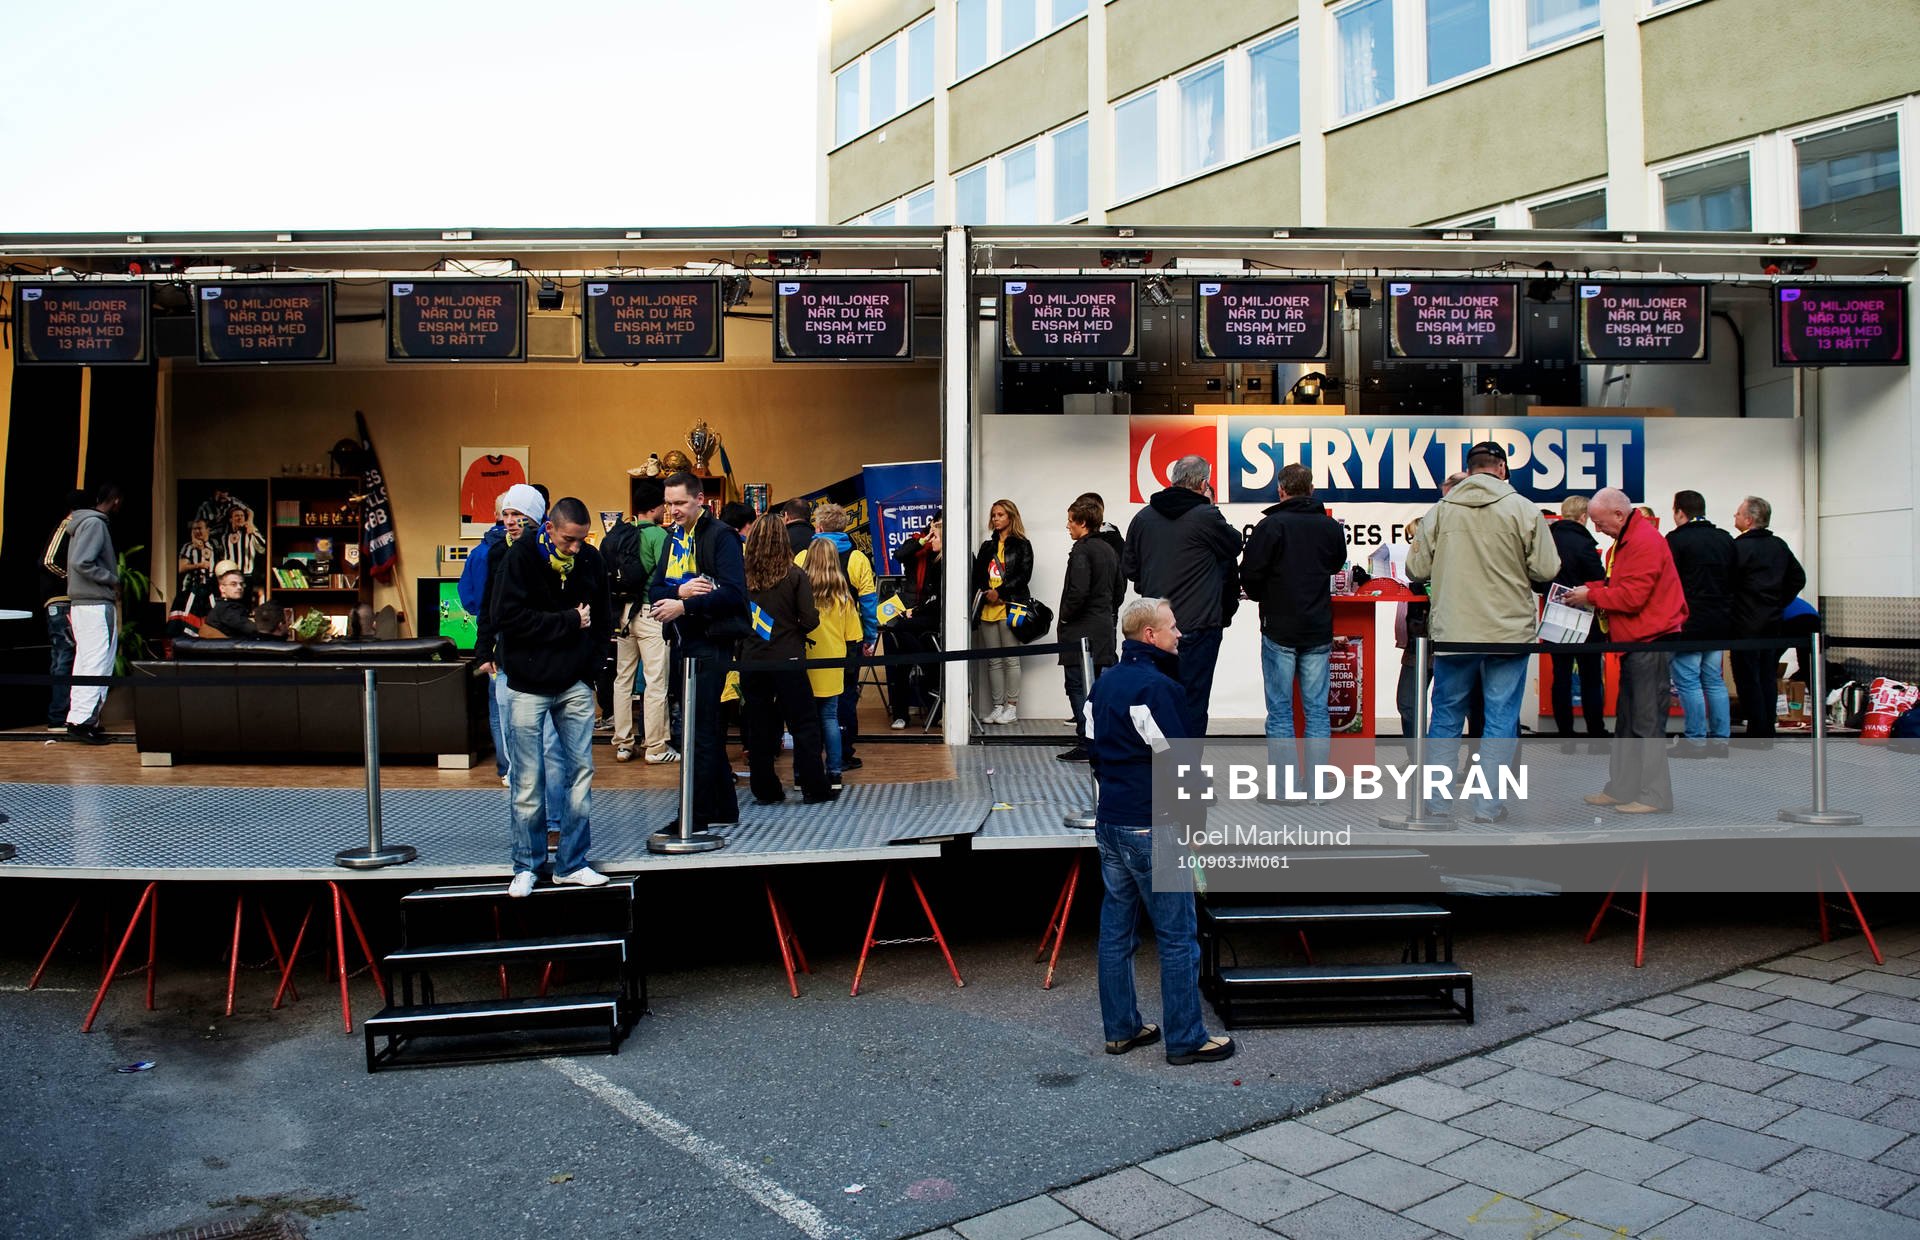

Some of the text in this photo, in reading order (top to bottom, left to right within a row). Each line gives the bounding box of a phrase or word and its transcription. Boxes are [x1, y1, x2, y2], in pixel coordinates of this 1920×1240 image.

[224, 298, 308, 309] 10 MILJONER
[415, 296, 501, 306] 10 MILJONER
[611, 295, 697, 306] 10 MILJONER
[802, 295, 889, 305] 10 MILJONER
[1029, 295, 1116, 304] 10 MILJONER
[1223, 296, 1309, 306] 10 MILJONER
[1413, 296, 1498, 306] 10 MILJONER
[1603, 298, 1686, 308] 10 MILJONER
[44, 301, 126, 310] 10 MILJONER
[1035, 305, 1110, 317] NÄR DU ÄR
[1803, 301, 1884, 311] 10 MILJONER
[50, 311, 121, 323] NÄR DU ÄR
[230, 309, 303, 322] NÄR DU ÄR
[421, 307, 495, 319] NÄR DU ÄR
[617, 306, 692, 319] NÄR DU ÄR
[808, 306, 883, 318] NÄR DU ÄR
[1229, 307, 1303, 319] NÄR DU ÄR
[1419, 307, 1493, 319] NÄR DU ÄR
[1609, 309, 1681, 321] NÄR DU ÄR
[1809, 311, 1879, 323] NÄR DU ÄR
[47, 326, 123, 336] ENSAM MED
[227, 324, 306, 335] ENSAM MED
[418, 322, 498, 332] ENSAM MED
[614, 321, 695, 332] ENSAM MED
[805, 321, 886, 331] ENSAM MED
[1032, 321, 1113, 330] ENSAM MED
[1226, 322, 1306, 332] ENSAM MED
[1416, 322, 1495, 332] ENSAM MED
[1606, 324, 1683, 333] ENSAM MED
[1806, 326, 1882, 336] ENSAM MED
[240, 335, 294, 347] 13 RÄTT
[431, 333, 486, 344] 13 RÄTT
[627, 332, 683, 345] 13 RÄTT
[818, 332, 874, 344] 13 RÄTT
[1044, 331, 1100, 343] 13 RÄTT
[1238, 333, 1293, 345] 13 RÄTT
[1428, 333, 1483, 345] 13 RÄTT
[1618, 335, 1672, 346] 13 RÄTT
[59, 337, 112, 349] 13 RÄTT
[1818, 337, 1870, 349] 13 RÄTT
[1241, 428, 1632, 490] STRYKTPSET
[1330, 681, 1355, 689] INSTER
